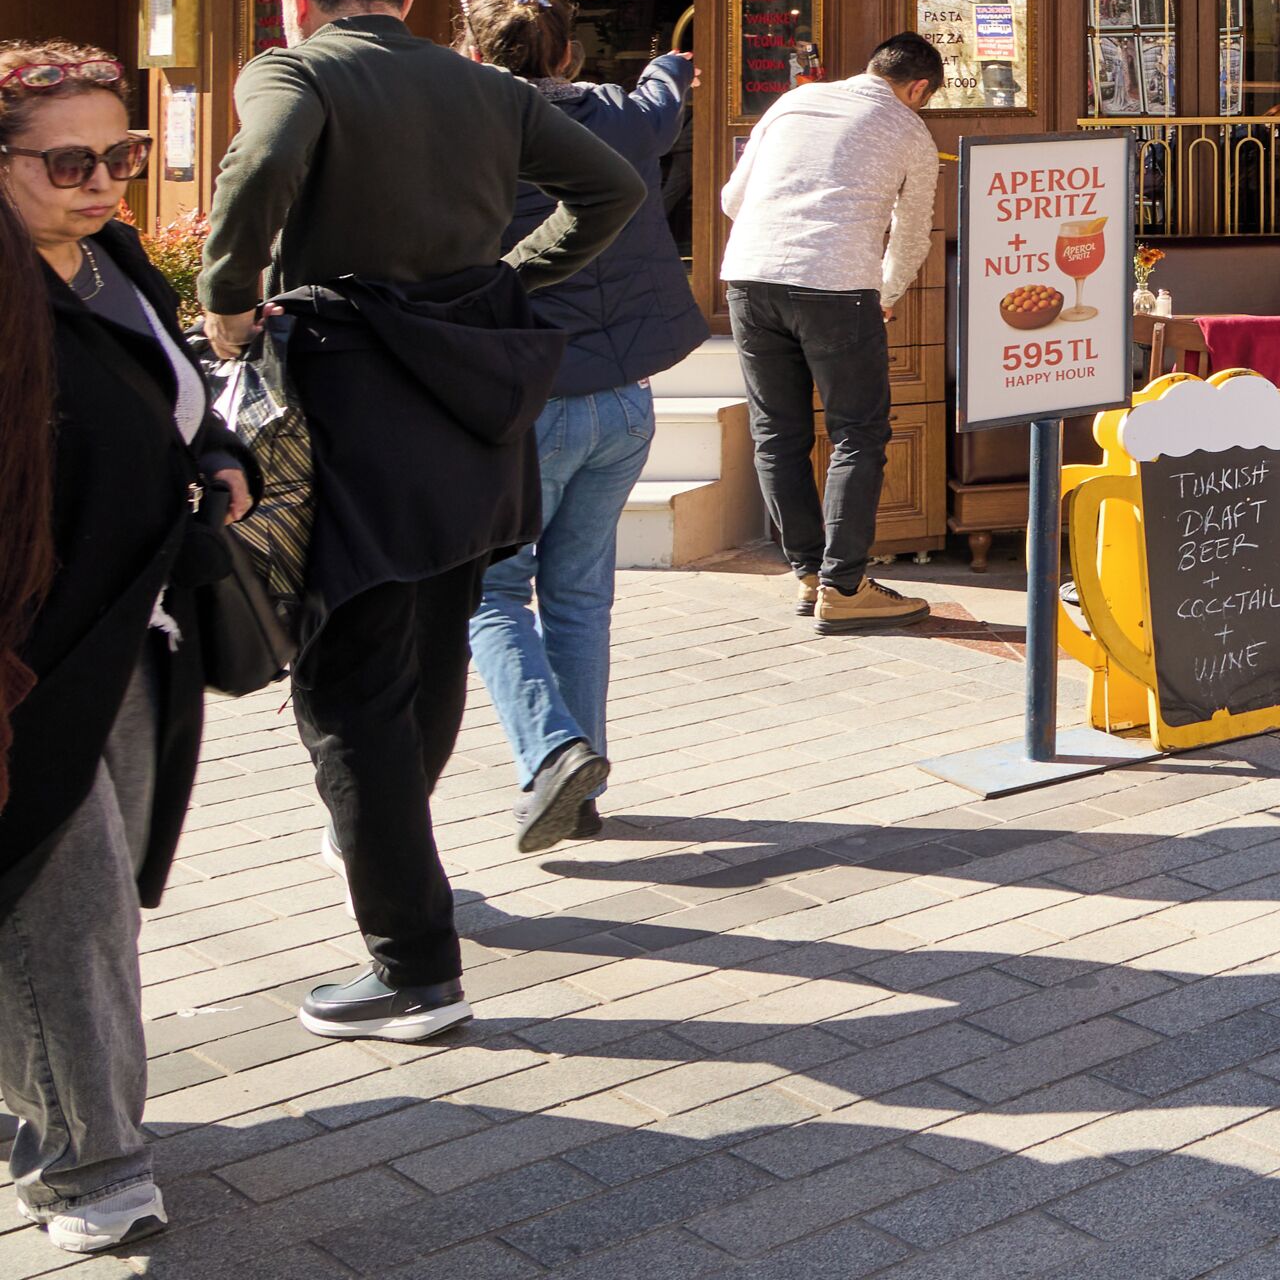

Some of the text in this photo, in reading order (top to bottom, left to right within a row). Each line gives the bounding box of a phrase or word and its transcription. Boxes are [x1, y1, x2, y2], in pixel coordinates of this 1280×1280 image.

[924, 11, 963, 22] PASTA
[925, 33, 964, 45] PIZZA
[987, 166, 1106, 196] APEROL
[996, 192, 1097, 222] SPRITZ
[1008, 233, 1027, 252] +
[1063, 241, 1096, 257] APEROL
[984, 252, 1050, 277] NUTS
[1068, 251, 1091, 262] SPRITZ
[1002, 338, 1098, 371] 595 TL
[1005, 366, 1095, 388] HAPPY HOUR
[1170, 460, 1271, 499] TURKISH
[1177, 498, 1268, 537] DRAFT
[1177, 533, 1259, 571] BEER
[1203, 571, 1220, 589] +
[1214, 623, 1234, 644] +
[1194, 641, 1267, 682] WINE
